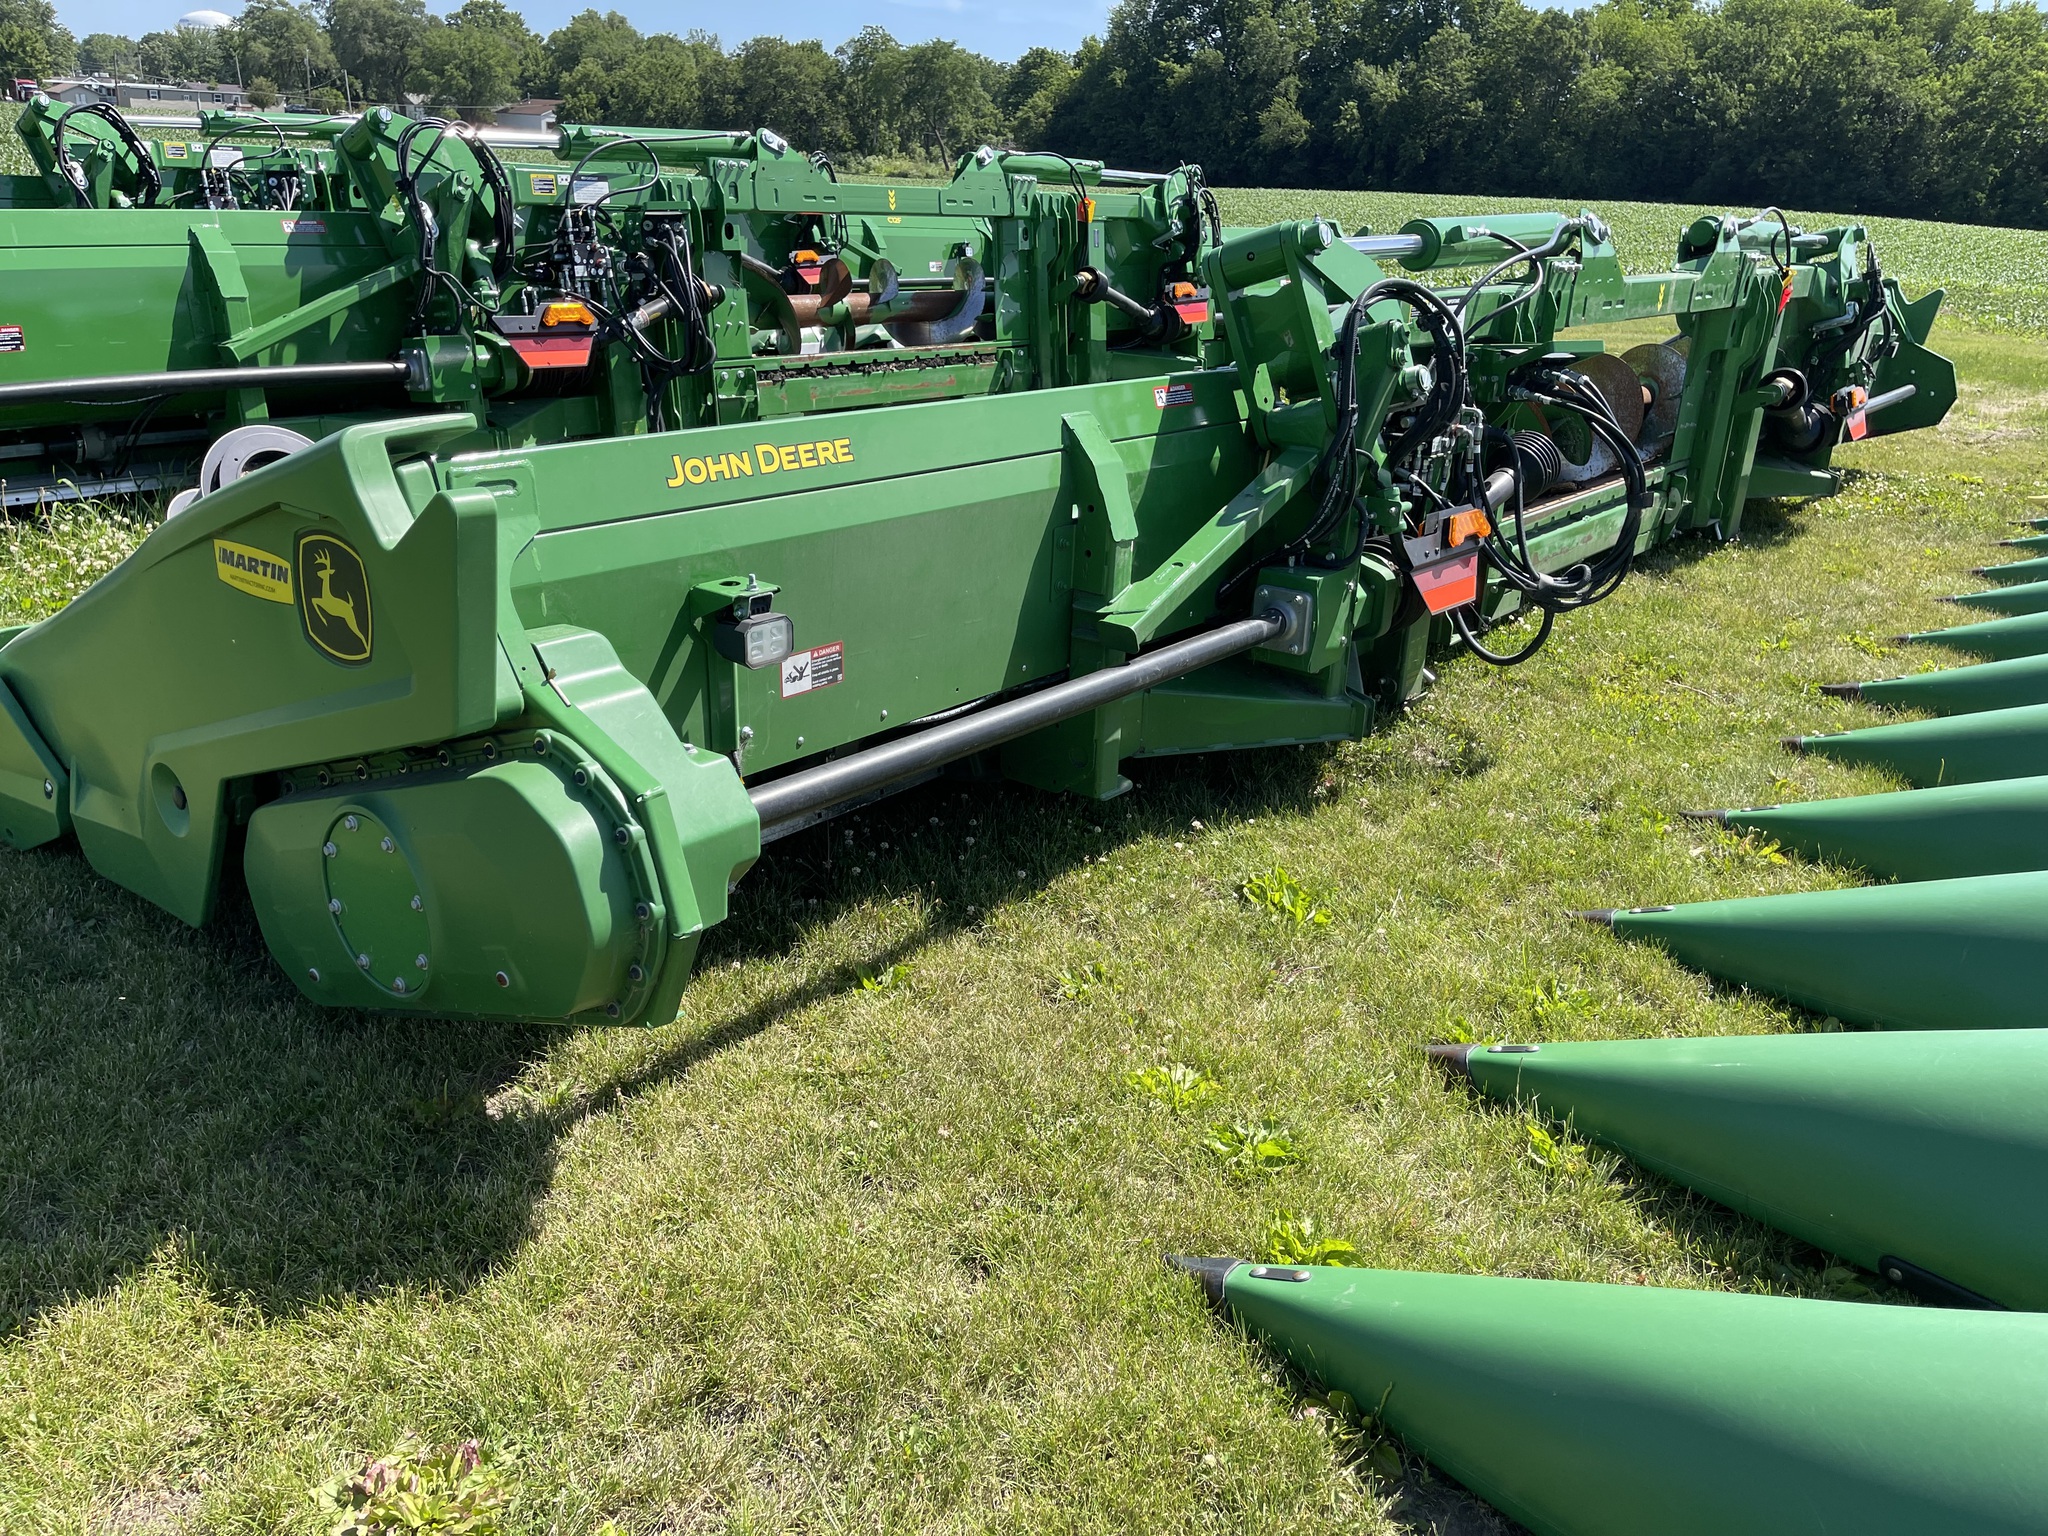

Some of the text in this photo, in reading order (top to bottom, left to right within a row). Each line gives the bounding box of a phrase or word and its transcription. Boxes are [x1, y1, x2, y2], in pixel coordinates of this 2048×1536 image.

[666, 437, 854, 488] JOHN DEERE
[220, 547, 288, 584] MARTIN
[819, 645, 840, 656] DANGER
